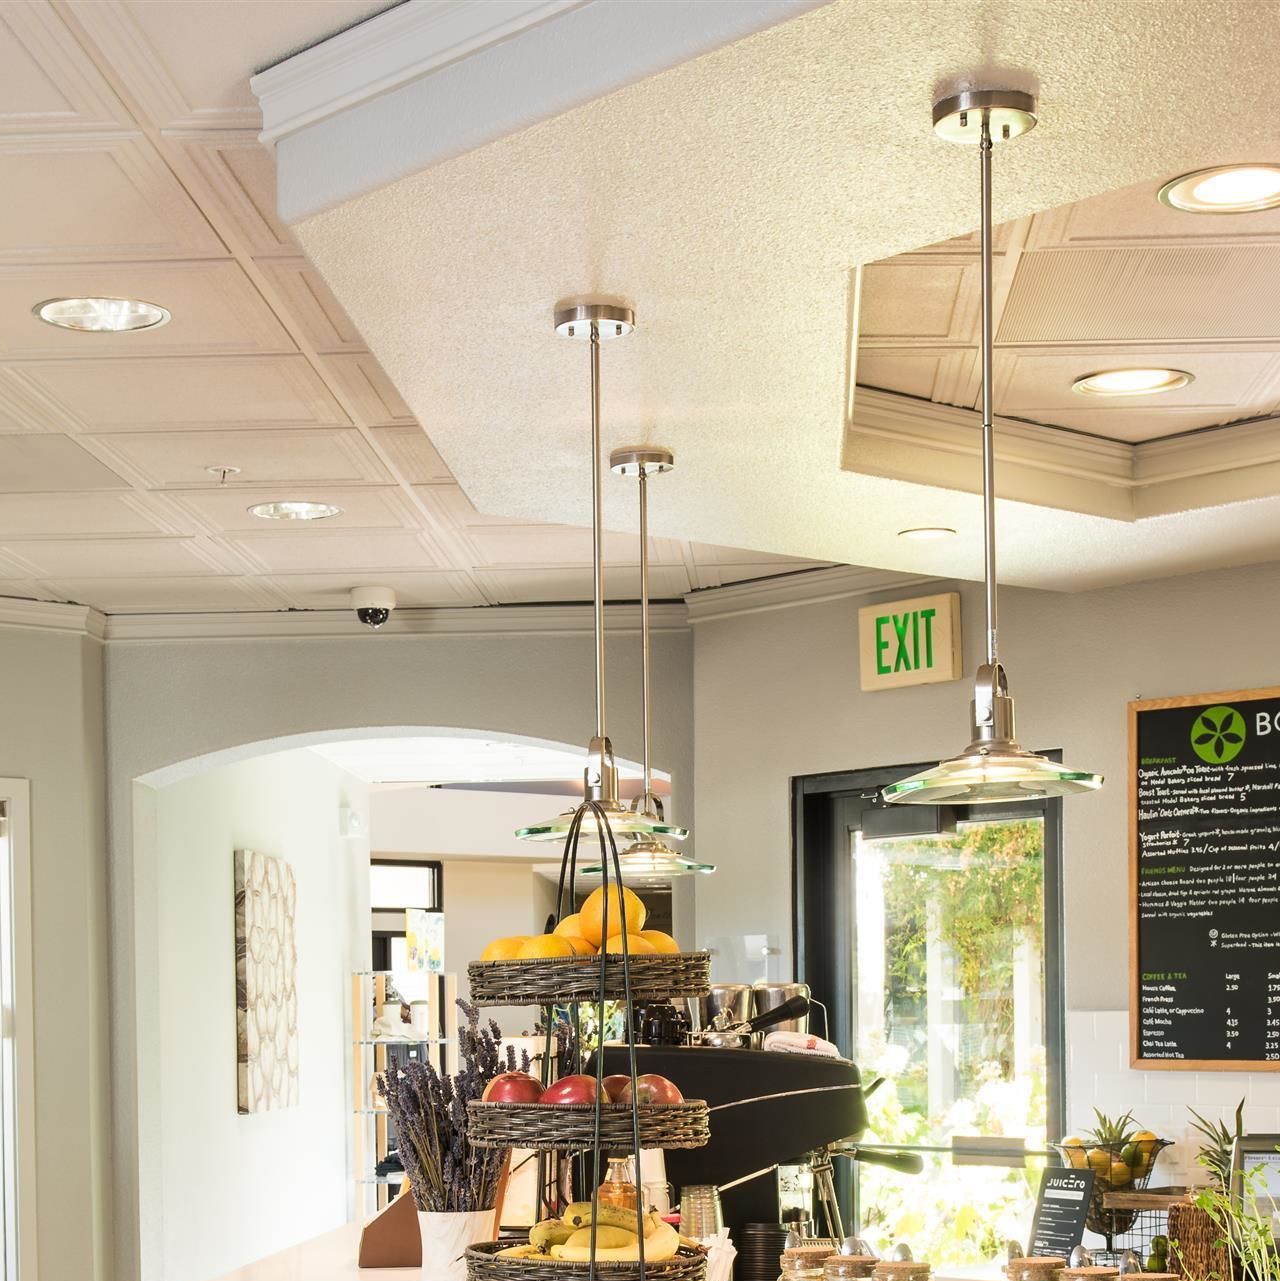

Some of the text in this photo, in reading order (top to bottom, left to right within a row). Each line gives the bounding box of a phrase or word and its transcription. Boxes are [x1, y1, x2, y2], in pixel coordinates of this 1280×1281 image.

[876, 608, 935, 675] EXIT
[1226, 1030, 1239, 1038] 3.50
[1266, 1031, 1280, 1039] 2.50
